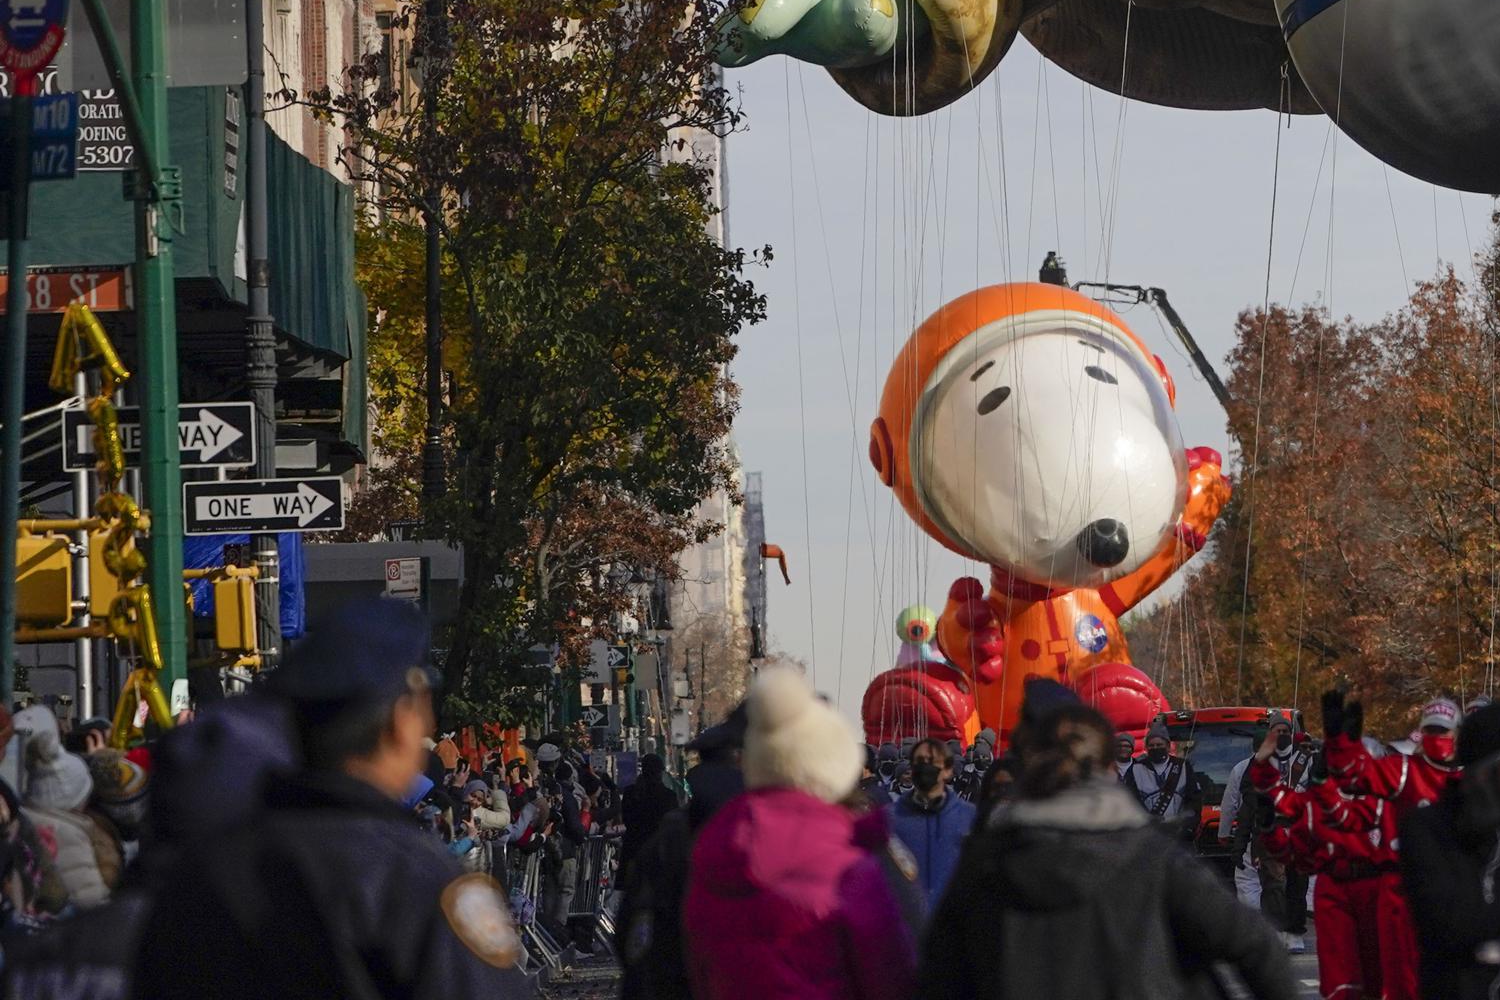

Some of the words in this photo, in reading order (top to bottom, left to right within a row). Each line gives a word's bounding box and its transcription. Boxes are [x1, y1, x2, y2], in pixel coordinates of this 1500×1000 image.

[33, 98, 70, 131] M10
[78, 104, 123, 119] ORATI
[32, 144, 68, 173] M72
[69, 273, 99, 308] ST
[208, 498, 252, 518] ONE
[274, 495, 318, 516] WAY
